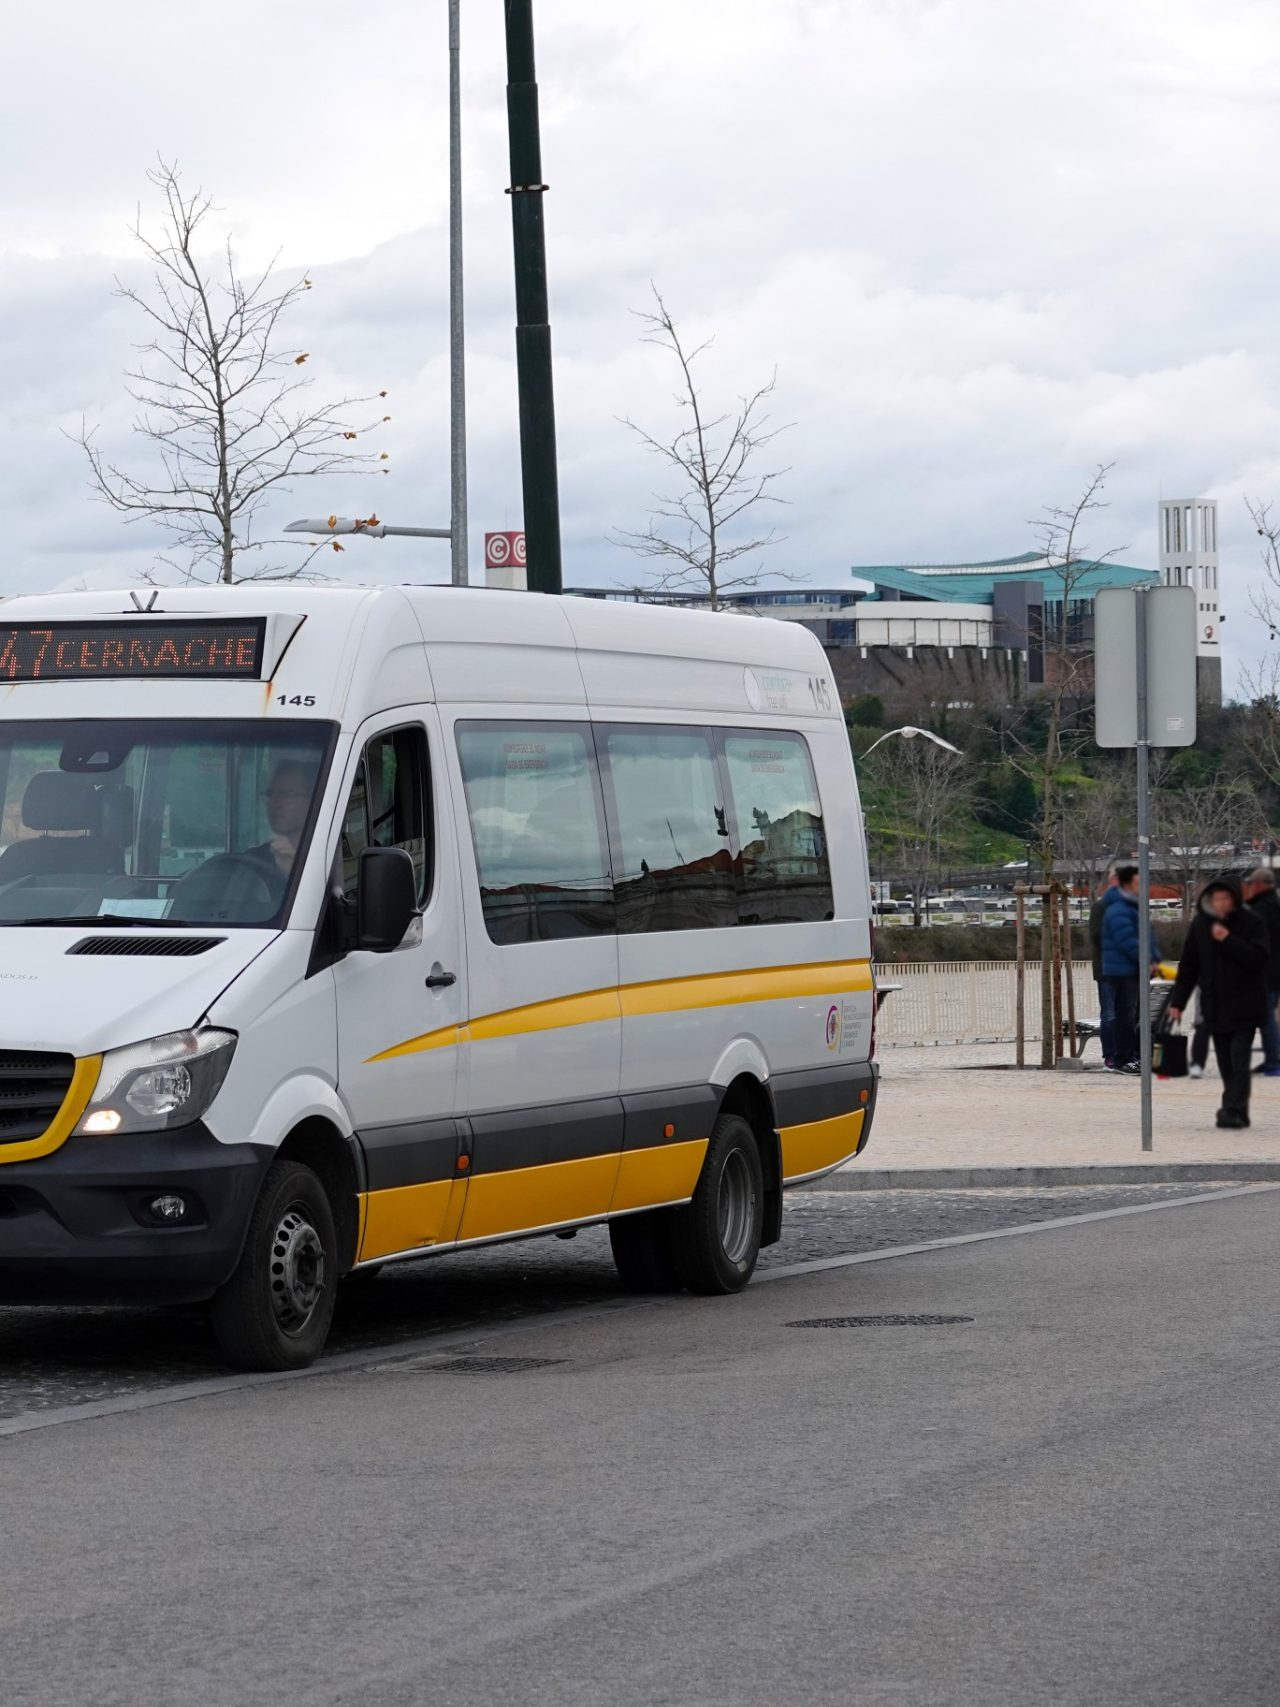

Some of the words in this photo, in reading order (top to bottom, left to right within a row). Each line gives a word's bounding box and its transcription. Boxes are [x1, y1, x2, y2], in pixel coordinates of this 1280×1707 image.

[56, 637, 257, 670] CERNACHE
[276, 694, 317, 708] 145
[808, 677, 832, 711] 145
